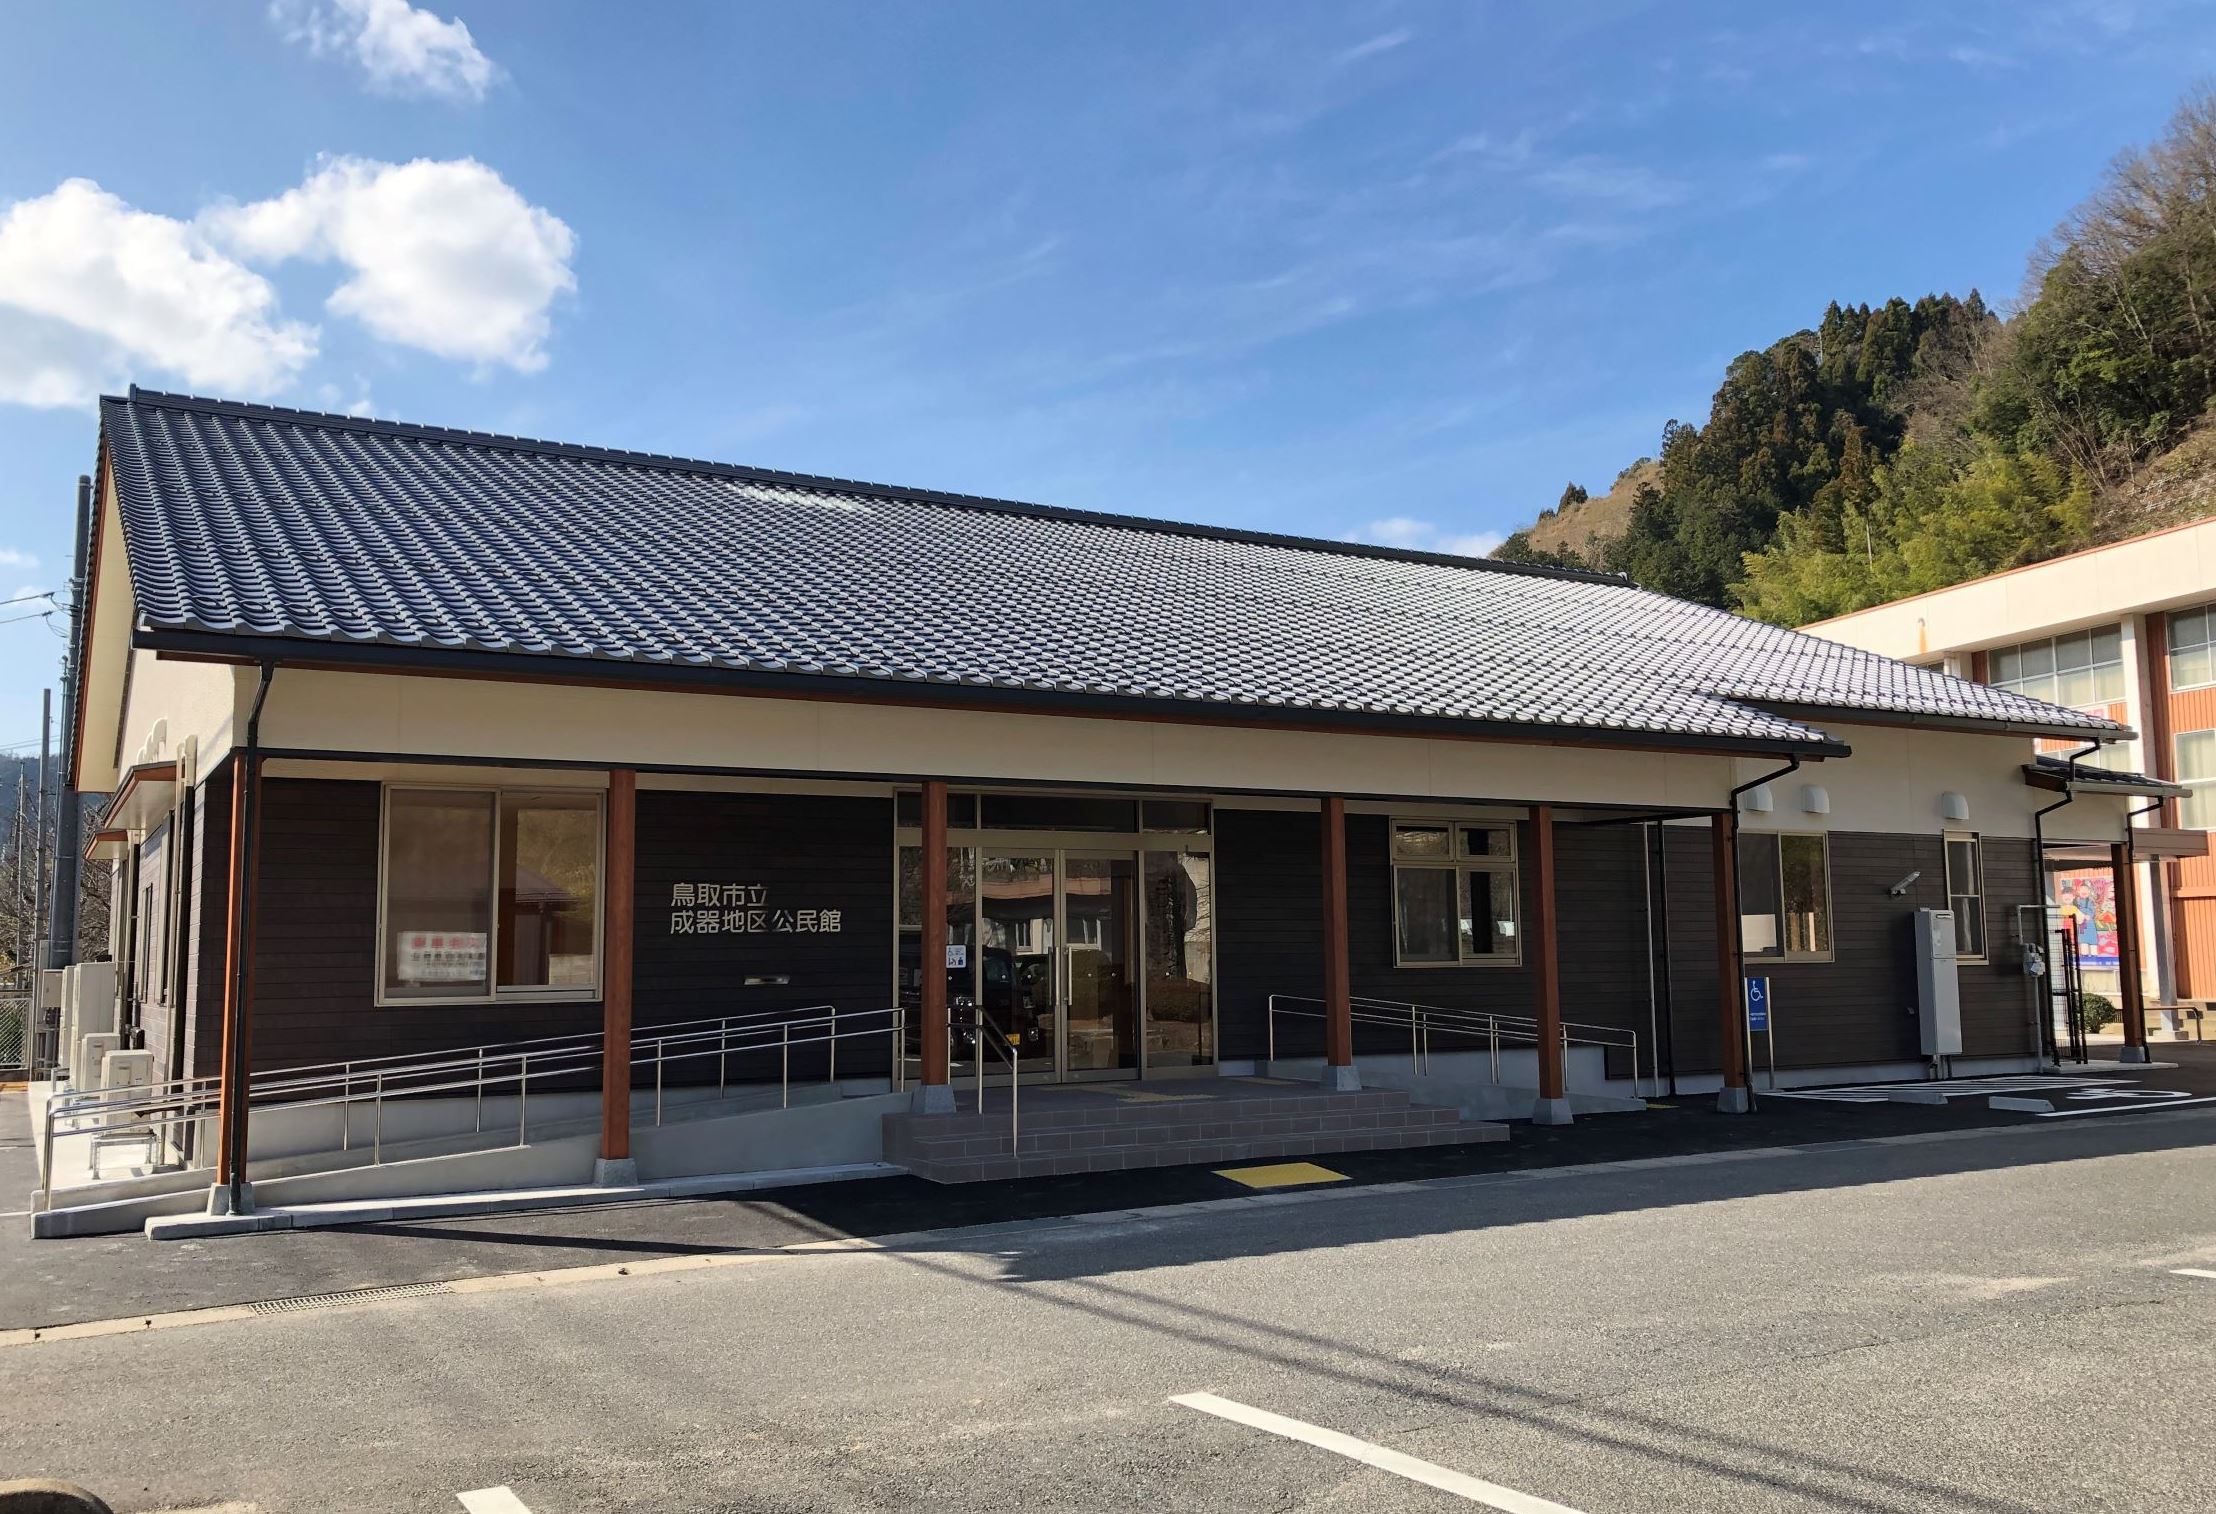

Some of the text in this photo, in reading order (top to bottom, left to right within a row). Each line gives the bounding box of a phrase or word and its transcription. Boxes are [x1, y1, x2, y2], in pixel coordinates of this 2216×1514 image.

[671, 882, 768, 907] 鳥取市立
[670, 909, 842, 934] 成器地区公民館
